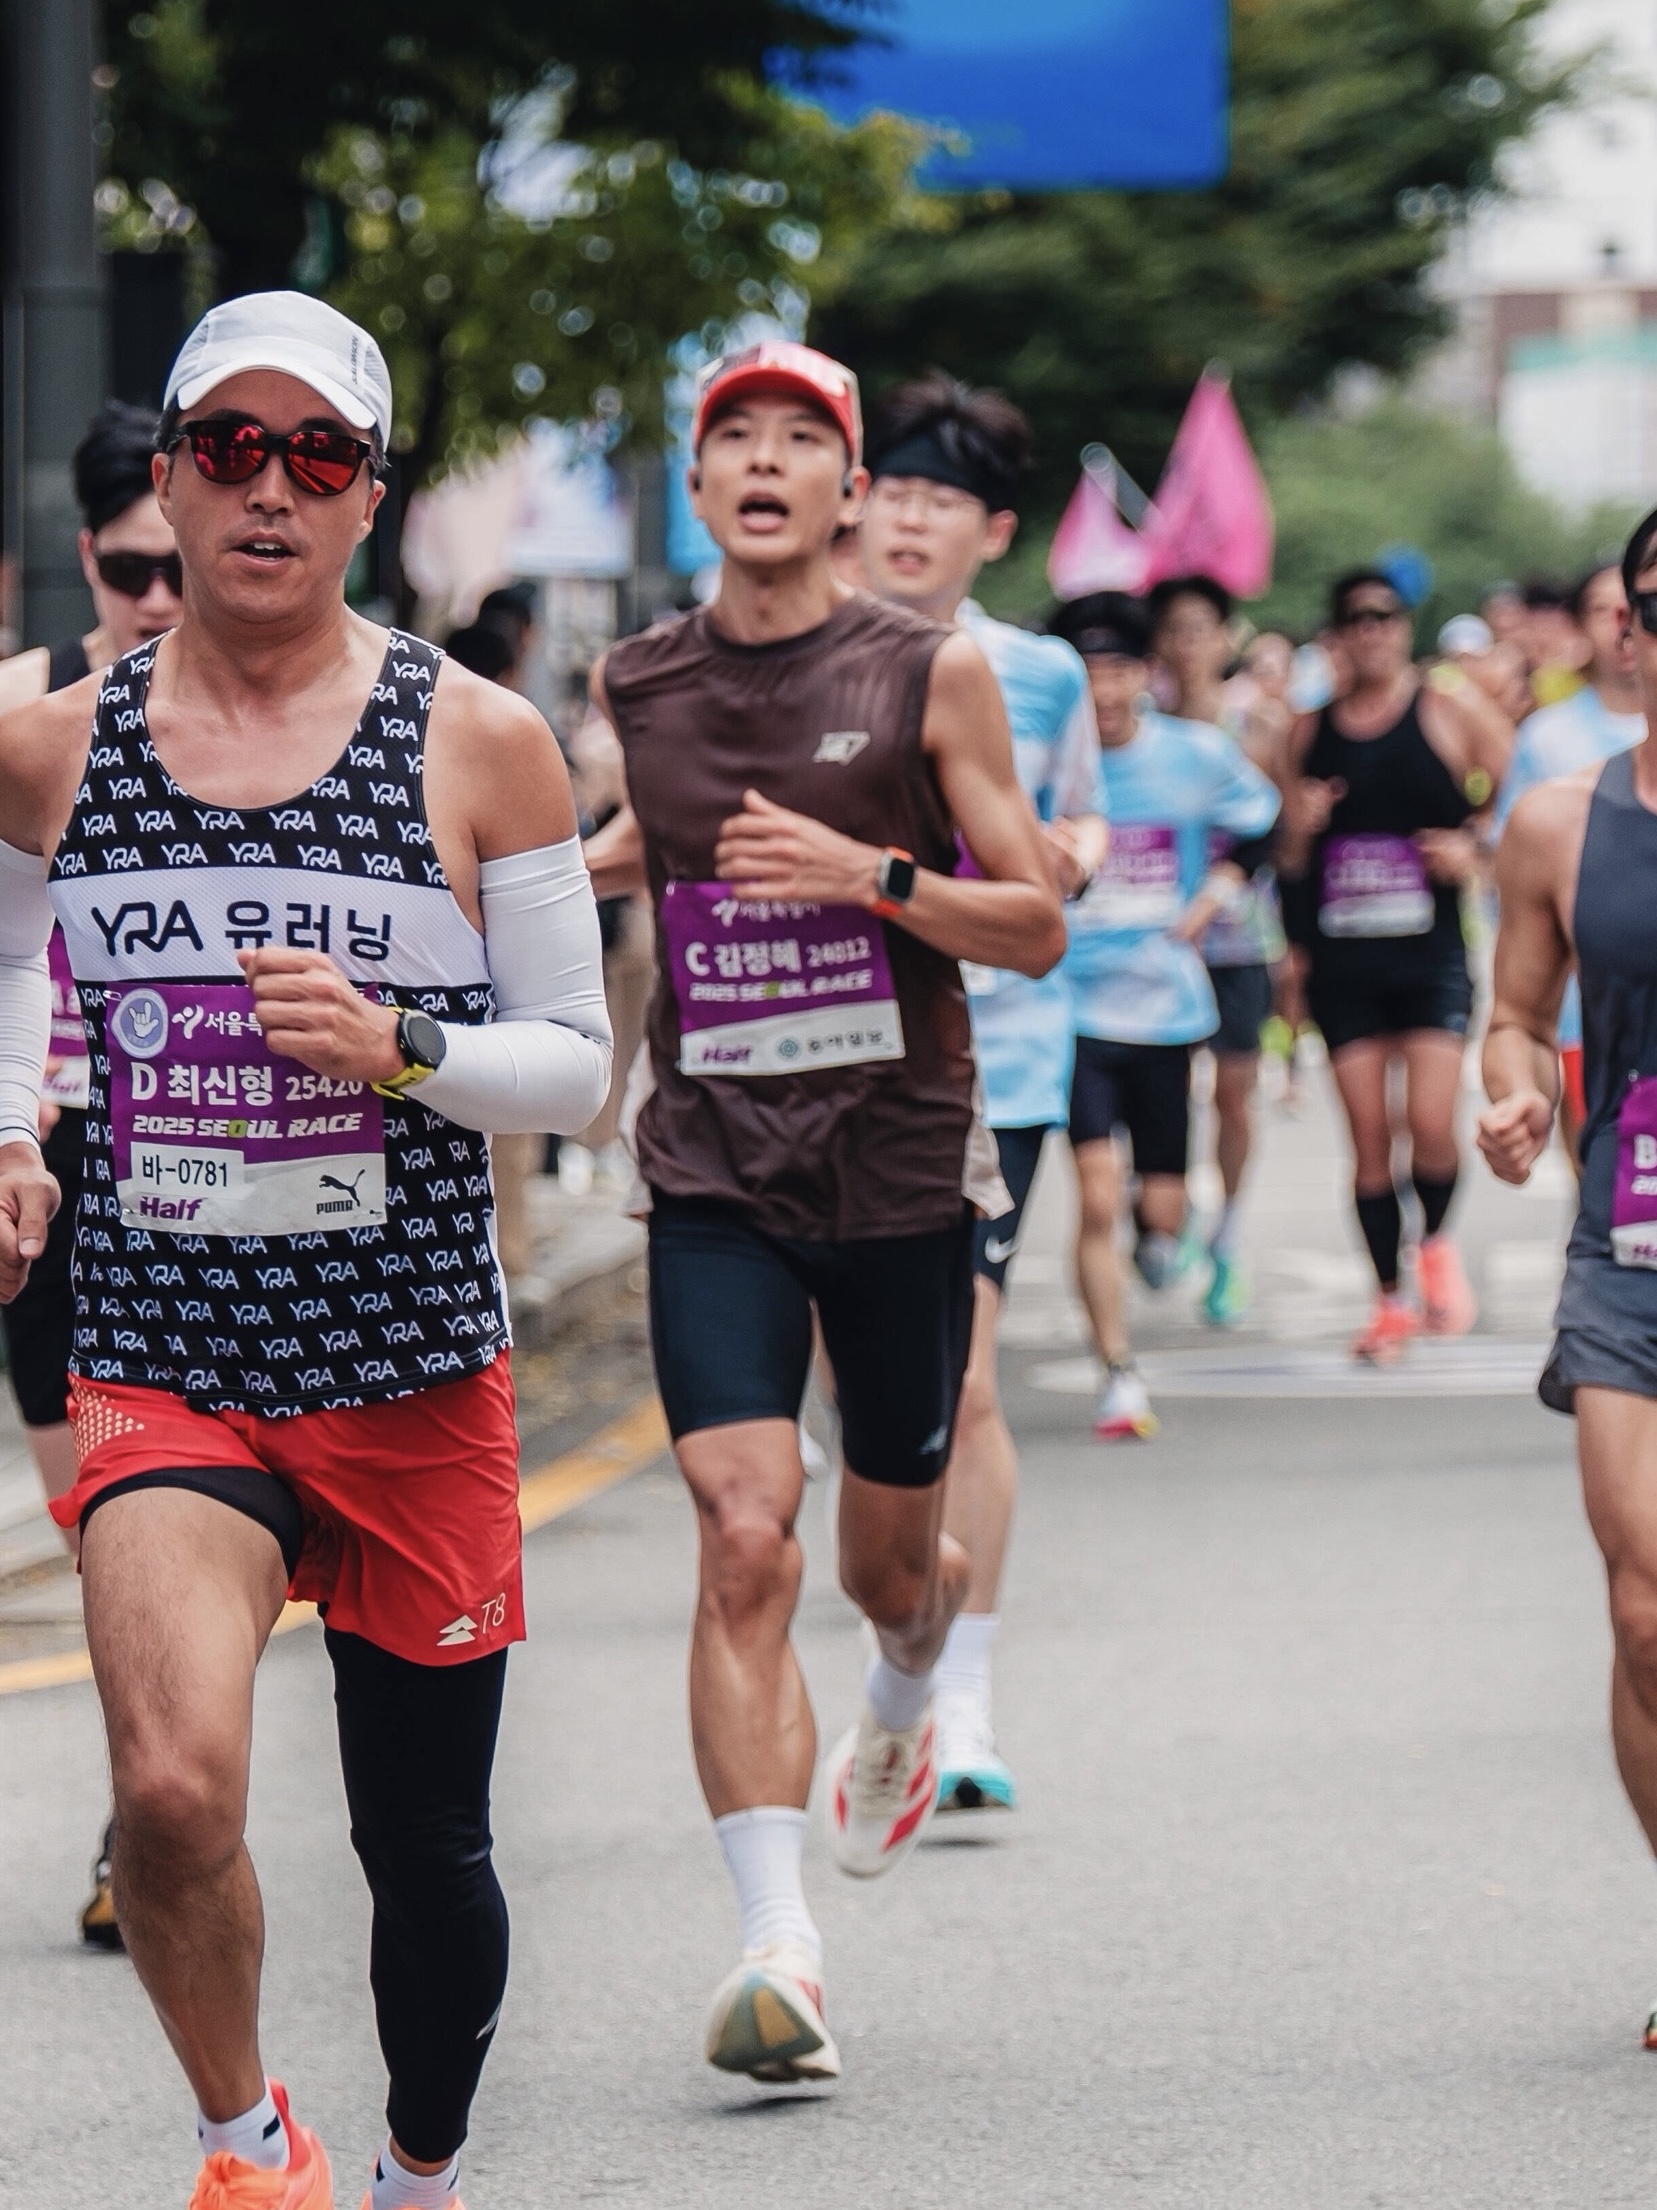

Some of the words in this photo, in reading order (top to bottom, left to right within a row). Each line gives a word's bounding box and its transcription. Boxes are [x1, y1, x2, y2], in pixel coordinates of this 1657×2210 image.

[389, 637, 410, 654] RA
[392, 661, 431, 682] YRA
[99, 684, 130, 704] YRA
[371, 683, 398, 705] RA
[115, 708, 145, 732] YRA
[380, 716, 418, 741] YRA
[89, 747, 124, 768] YRA
[348, 745, 385, 769] YRA
[109, 778, 146, 799] YRA
[369, 782, 409, 807] YRA
[83, 814, 117, 836] YRA
[135, 810, 176, 832] YRA
[194, 810, 244, 829] YRA
[269, 810, 316, 832] YRA
[337, 814, 378, 839] YRA
[55, 852, 87, 875] YRA
[103, 847, 143, 869] YRA
[161, 843, 208, 864] YRA
[228, 843, 276, 863] YRA
[298, 845, 342, 870] YRA
[362, 853, 404, 879] YRA
[422, 861, 448, 886] YR
[91, 899, 203, 957] YRA
[225, 900, 391, 961] 유러닝
[685, 941, 711, 977] C
[81, 991, 106, 1007] YRA
[462, 992, 487, 1011] YRA
[130, 1062, 158, 1100] D
[167, 1064, 273, 1106] 최신형
[102, 1124, 114, 1145] YR
[132, 1114, 195, 1136] 2025
[196, 1118, 283, 1139] SEOUL
[287, 1112, 364, 1138] RACE
[384, 1119, 409, 1138] RA
[142, 1154, 228, 1187] 바-0781
[401, 1147, 435, 1169] YRA
[385, 1186, 407, 1206] RA
[426, 1179, 459, 1202] YRA
[464, 1176, 488, 1197] YRA
[104, 1196, 120, 1217] YR
[139, 1196, 203, 1222] Half
[316, 1200, 354, 1215] PUMA
[402, 1217, 438, 1239] YRA
[453, 1212, 474, 1233] YR
[169, 1234, 210, 1254] YRA
[228, 1236, 267, 1254] YRA
[287, 1232, 329, 1250] YRA
[347, 1227, 385, 1246] YRA
[106, 1267, 137, 1287] YRA
[146, 1265, 185, 1286] YRA
[199, 1269, 239, 1289] YRA
[256, 1267, 298, 1289] YRA
[315, 1262, 359, 1283] YRA
[377, 1254, 416, 1276] YRA
[426, 1250, 463, 1271] YRA
[176, 1301, 214, 1322] YRA
[231, 1305, 273, 1325] YRA
[290, 1298, 332, 1321] YRA
[351, 1292, 393, 1313] YRA
[410, 1286, 452, 1305] YRA
[454, 1280, 481, 1303] YRA
[114, 1329, 148, 1352] YRA
[206, 1336, 243, 1358] YRA
[261, 1337, 304, 1359] YRA
[320, 1329, 362, 1352] YRA
[382, 1321, 425, 1344] YRA
[444, 1315, 479, 1335] YRA
[480, 1310, 499, 1332] YRA
[90, 1359, 124, 1379] YRA
[240, 1369, 277, 1394] YRA
[295, 1367, 336, 1390] YRA
[354, 1359, 399, 1382] YRA
[417, 1351, 465, 1374] YRA
[481, 1592, 506, 1635] T8
